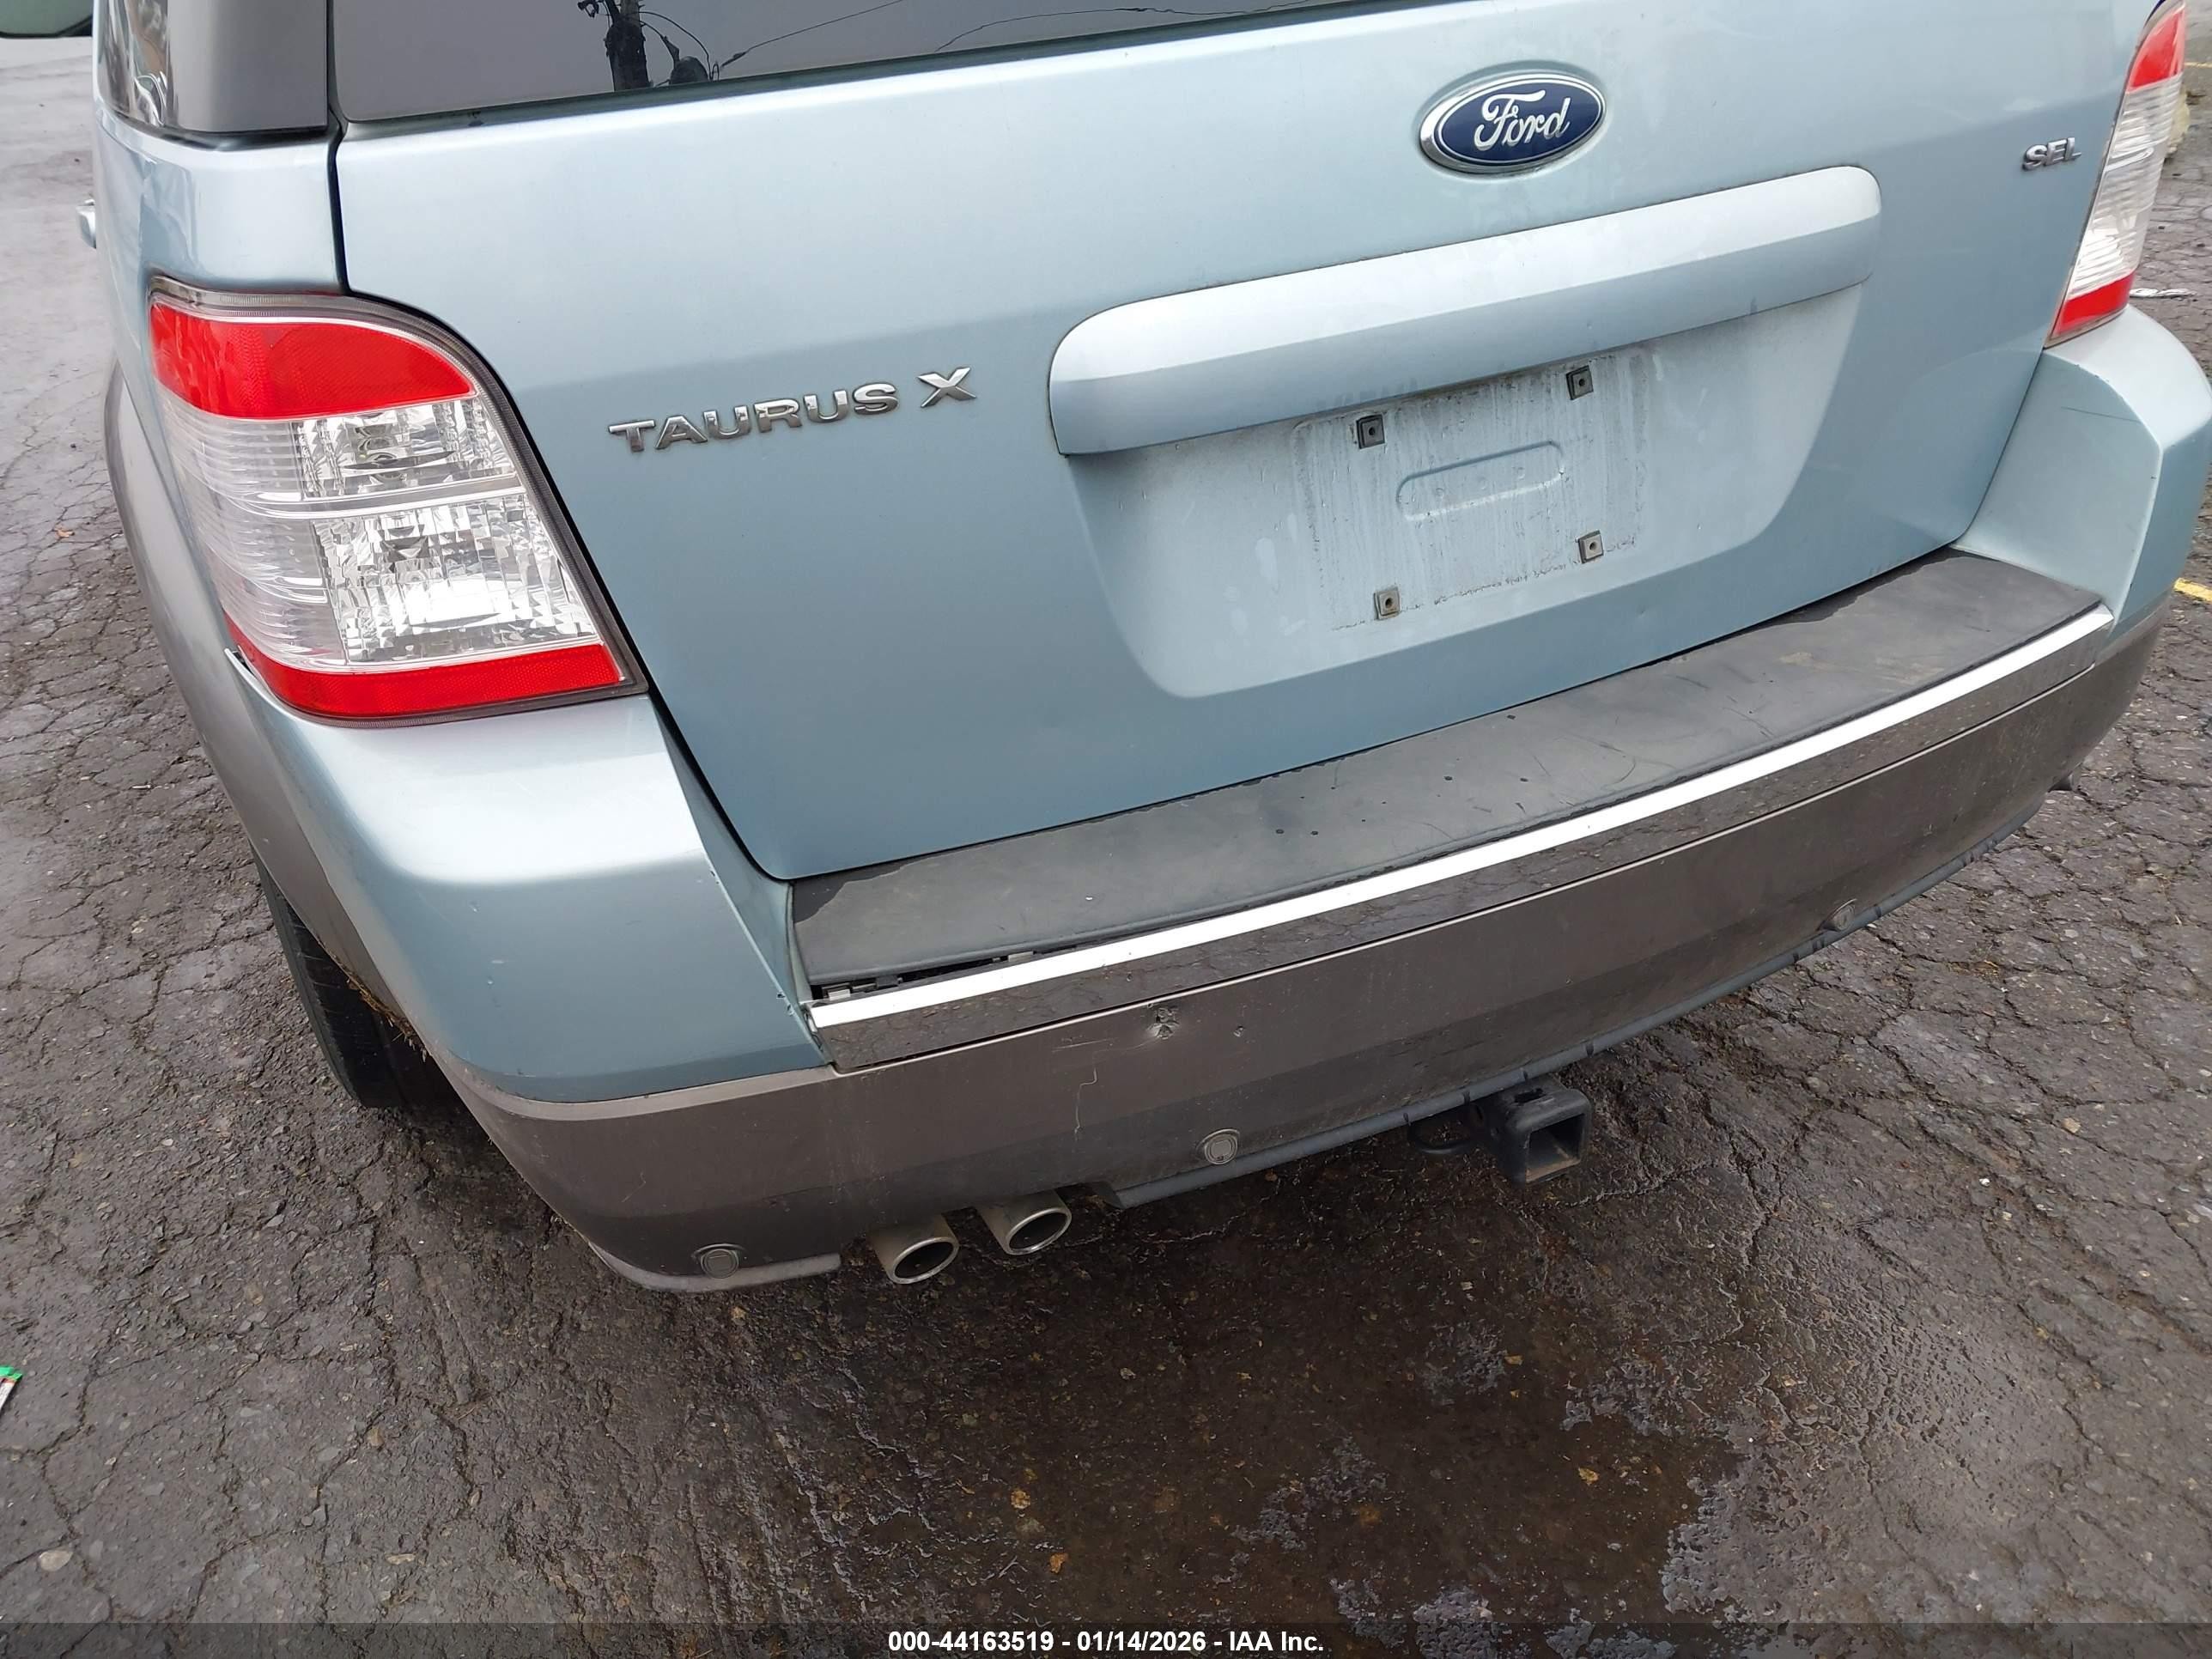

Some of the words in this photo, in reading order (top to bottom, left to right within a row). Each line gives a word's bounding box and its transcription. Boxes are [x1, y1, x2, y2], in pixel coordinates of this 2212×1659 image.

[1474, 90, 1571, 151] Ford
[2022, 137, 2082, 171] SEL
[608, 382, 899, 453] TAURUS
[916, 366, 977, 409] X
